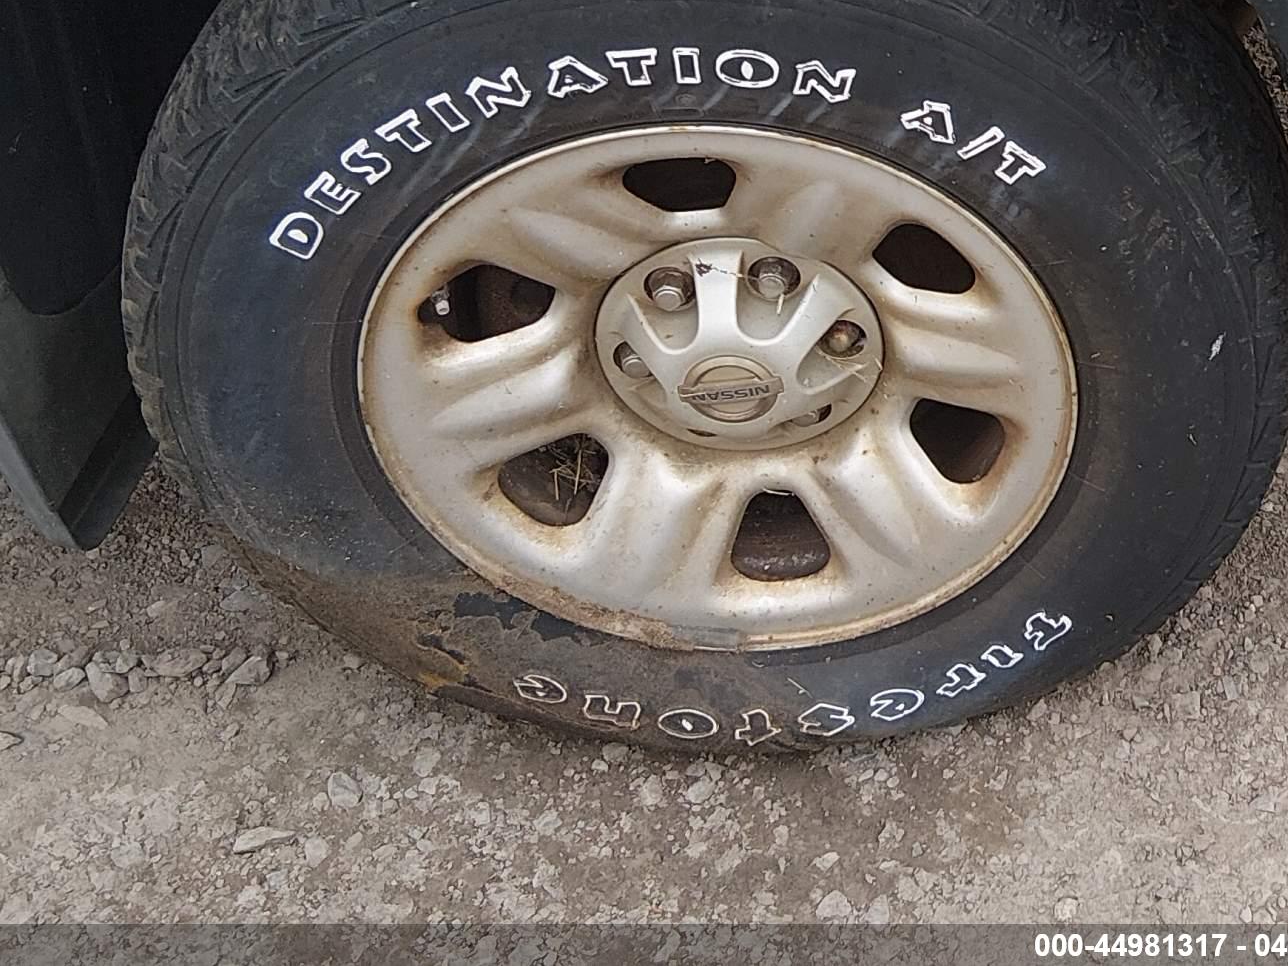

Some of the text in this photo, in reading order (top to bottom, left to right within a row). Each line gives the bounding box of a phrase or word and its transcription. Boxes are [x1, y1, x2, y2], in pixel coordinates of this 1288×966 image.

[267, 47, 1047, 261] DESTINATION A/T
[692, 384, 770, 402] NISSAN
